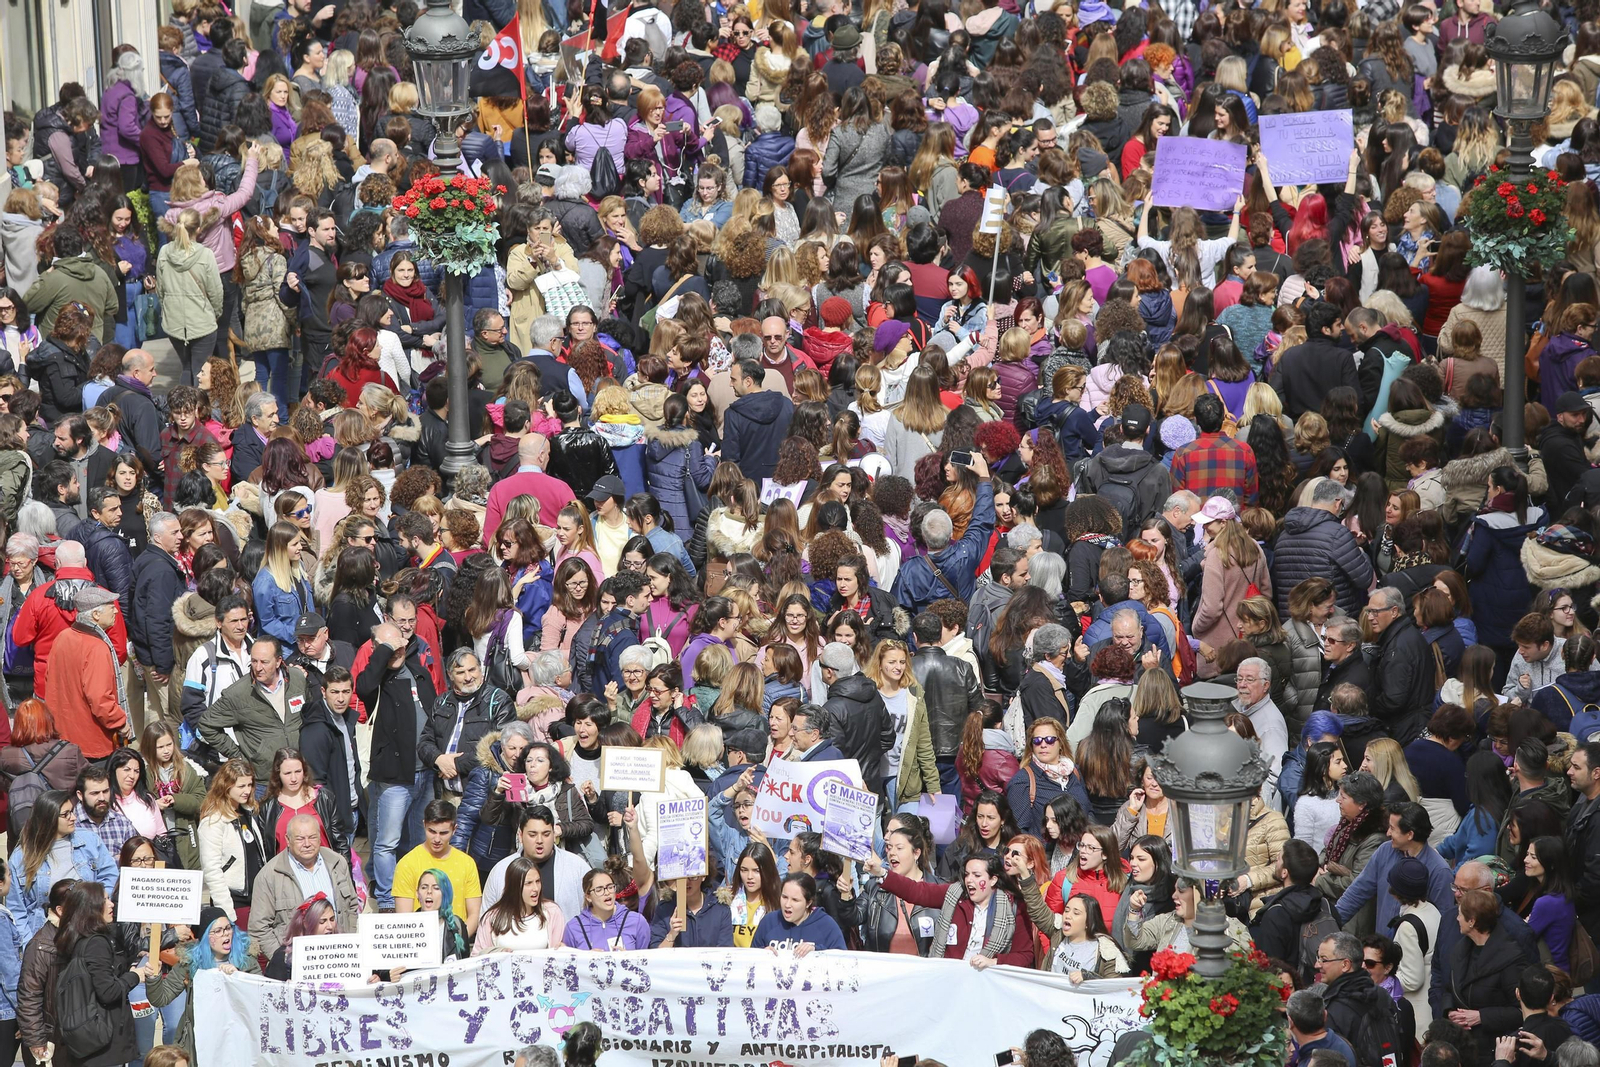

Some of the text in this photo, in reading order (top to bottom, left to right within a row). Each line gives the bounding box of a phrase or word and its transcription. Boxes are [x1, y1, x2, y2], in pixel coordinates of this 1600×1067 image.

[830, 783, 876, 807] 8 MARZO
[659, 799, 704, 815] 8 MARZO
[756, 805, 783, 823] YOU
[316, 943, 353, 951] INVIERNO
[318, 952, 346, 960] OTOÑO
[1058, 951, 1082, 970] BELIEVE
[1062, 966, 1069, 975] IN
[259, 981, 350, 1015] NOS
[374, 954, 652, 1010] QUEREMOS
[259, 1010, 414, 1059] LIBRES
[458, 1005, 490, 1045] Y
[706, 1041, 720, 1056] Y
